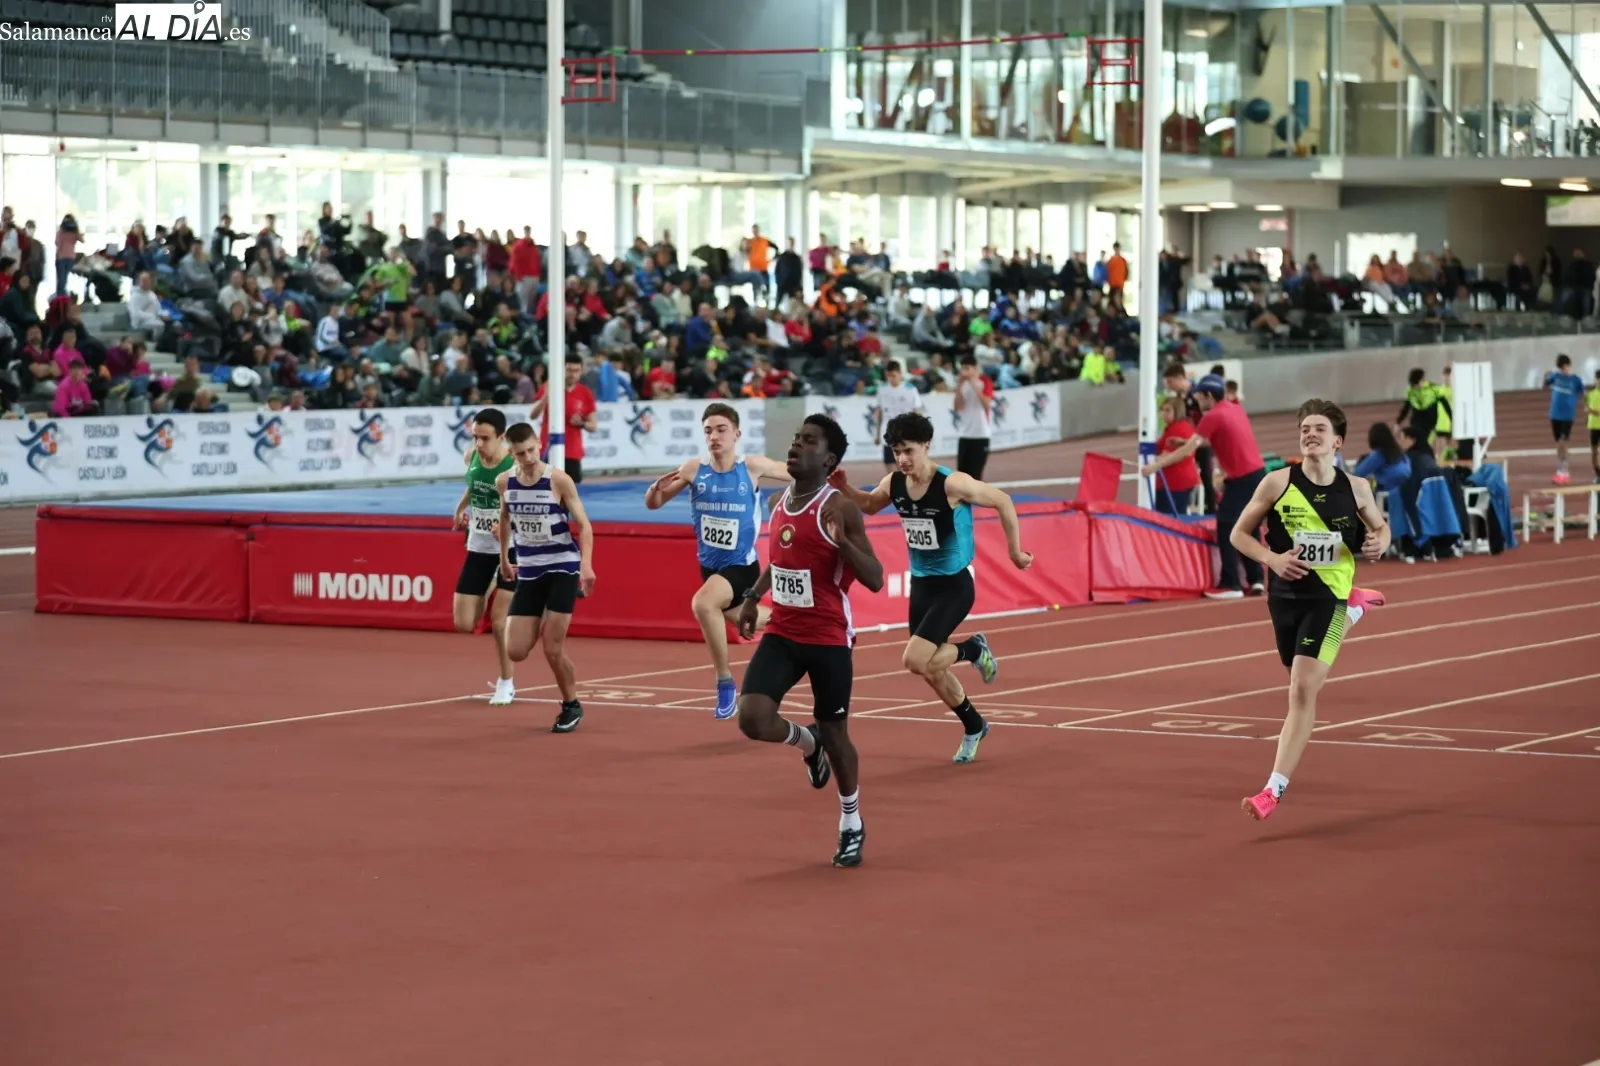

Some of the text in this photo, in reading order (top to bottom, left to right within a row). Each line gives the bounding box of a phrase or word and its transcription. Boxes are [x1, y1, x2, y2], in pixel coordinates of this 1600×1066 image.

[508, 504, 550, 514] RACING
[520, 521, 542, 533] 2797
[704, 526, 733, 546] 2822
[907, 529, 932, 546] 2905
[1298, 543, 1335, 562] 2811
[318, 572, 433, 602] MONDO
[775, 575, 805, 595] 2785
